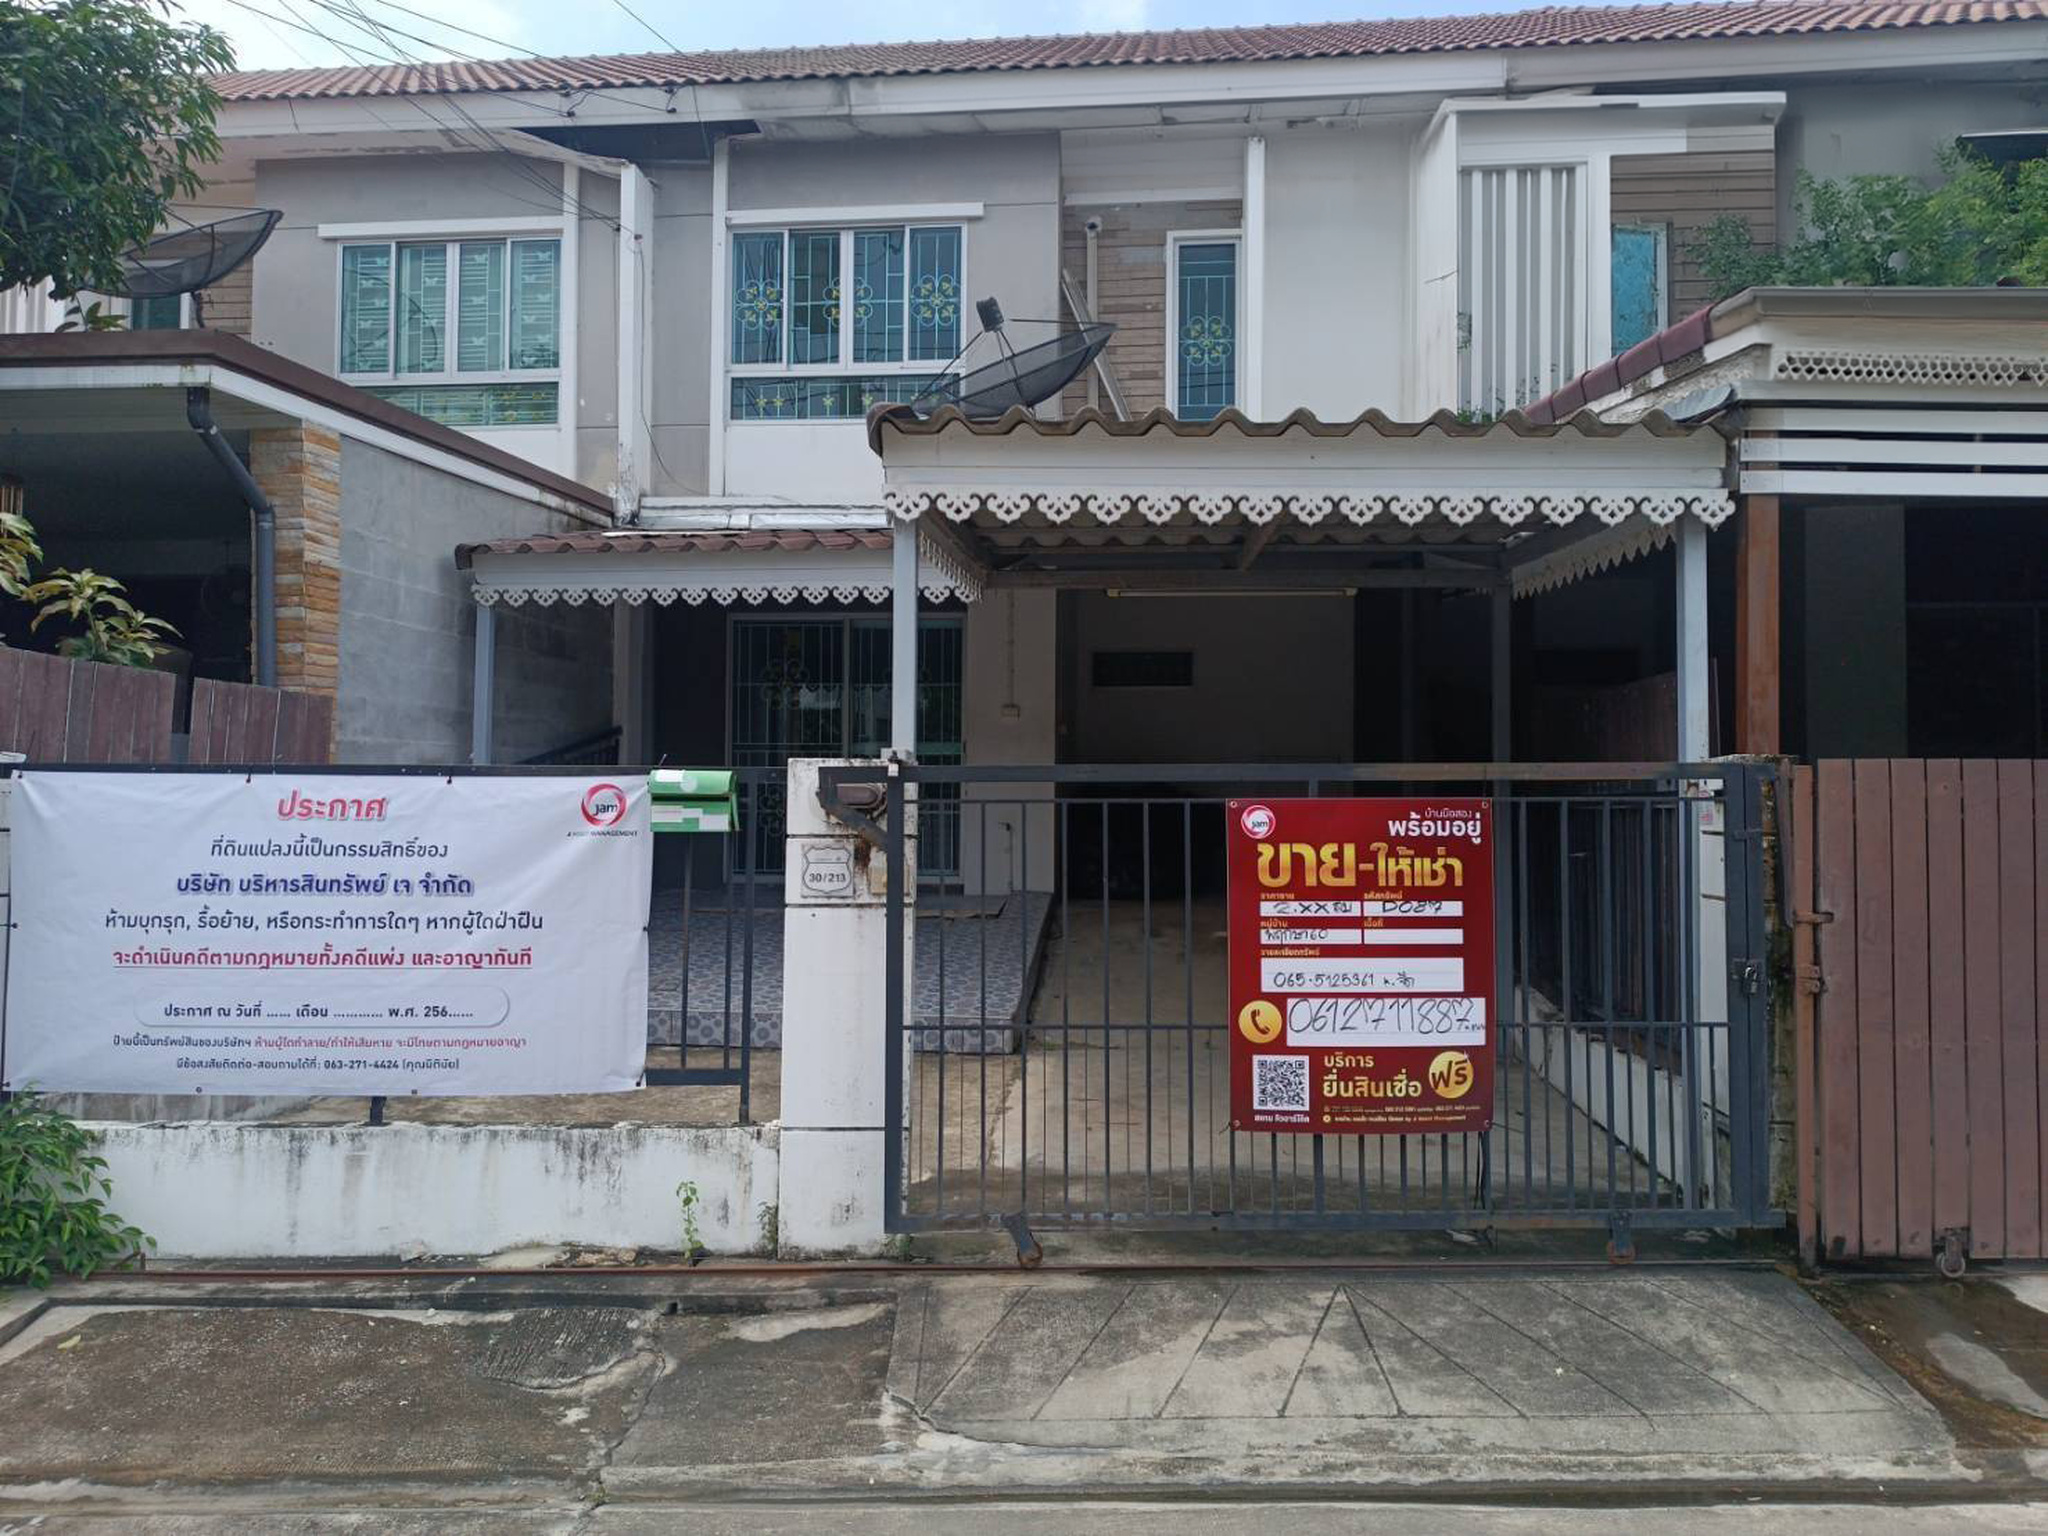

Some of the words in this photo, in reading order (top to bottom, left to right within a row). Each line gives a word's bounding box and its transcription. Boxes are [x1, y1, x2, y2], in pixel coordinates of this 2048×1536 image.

[277, 789, 388, 821] ประกาศ
[1424, 807, 1472, 819] บ้านมือสอง
[1388, 811, 1481, 844] พร้อมอยู่
[210, 833, 448, 858] ที่ดินแปลงนี้เป็นกรรมสิทธิ์ของ
[1257, 842, 1464, 888] ขาย-ให้เช่า
[176, 873, 232, 895] บริษัท
[238, 873, 387, 895] บริหารสินทรัพย์
[393, 879, 411, 894] เจ
[419, 873, 473, 894] จำกัด
[809, 873, 846, 883] 30/213
[105, 908, 190, 935] ห้ามบุกรุก,
[197, 905, 259, 931] รื้อย้าย,
[266, 910, 419, 933] หรือกระทำการใดๆ
[426, 910, 543, 935] หากผู้ใดฝ่าฝืน
[412, 946, 533, 969] และอาญาทันที
[164, 1003, 213, 1018] ประกาศ
[217, 1006, 231, 1018] ณ
[236, 1000, 263, 1018] วันที่
[296, 1004, 329, 1018] เดือน
[388, 1007, 418, 1018] พ.ศ.
[324, 1058, 399, 1069] 063-271-4424
[1324, 1052, 1374, 1068] บริการ
[1323, 1068, 1422, 1098] ยื่นสินเชื่อ
[1431, 1059, 1468, 1091] ฟรี
